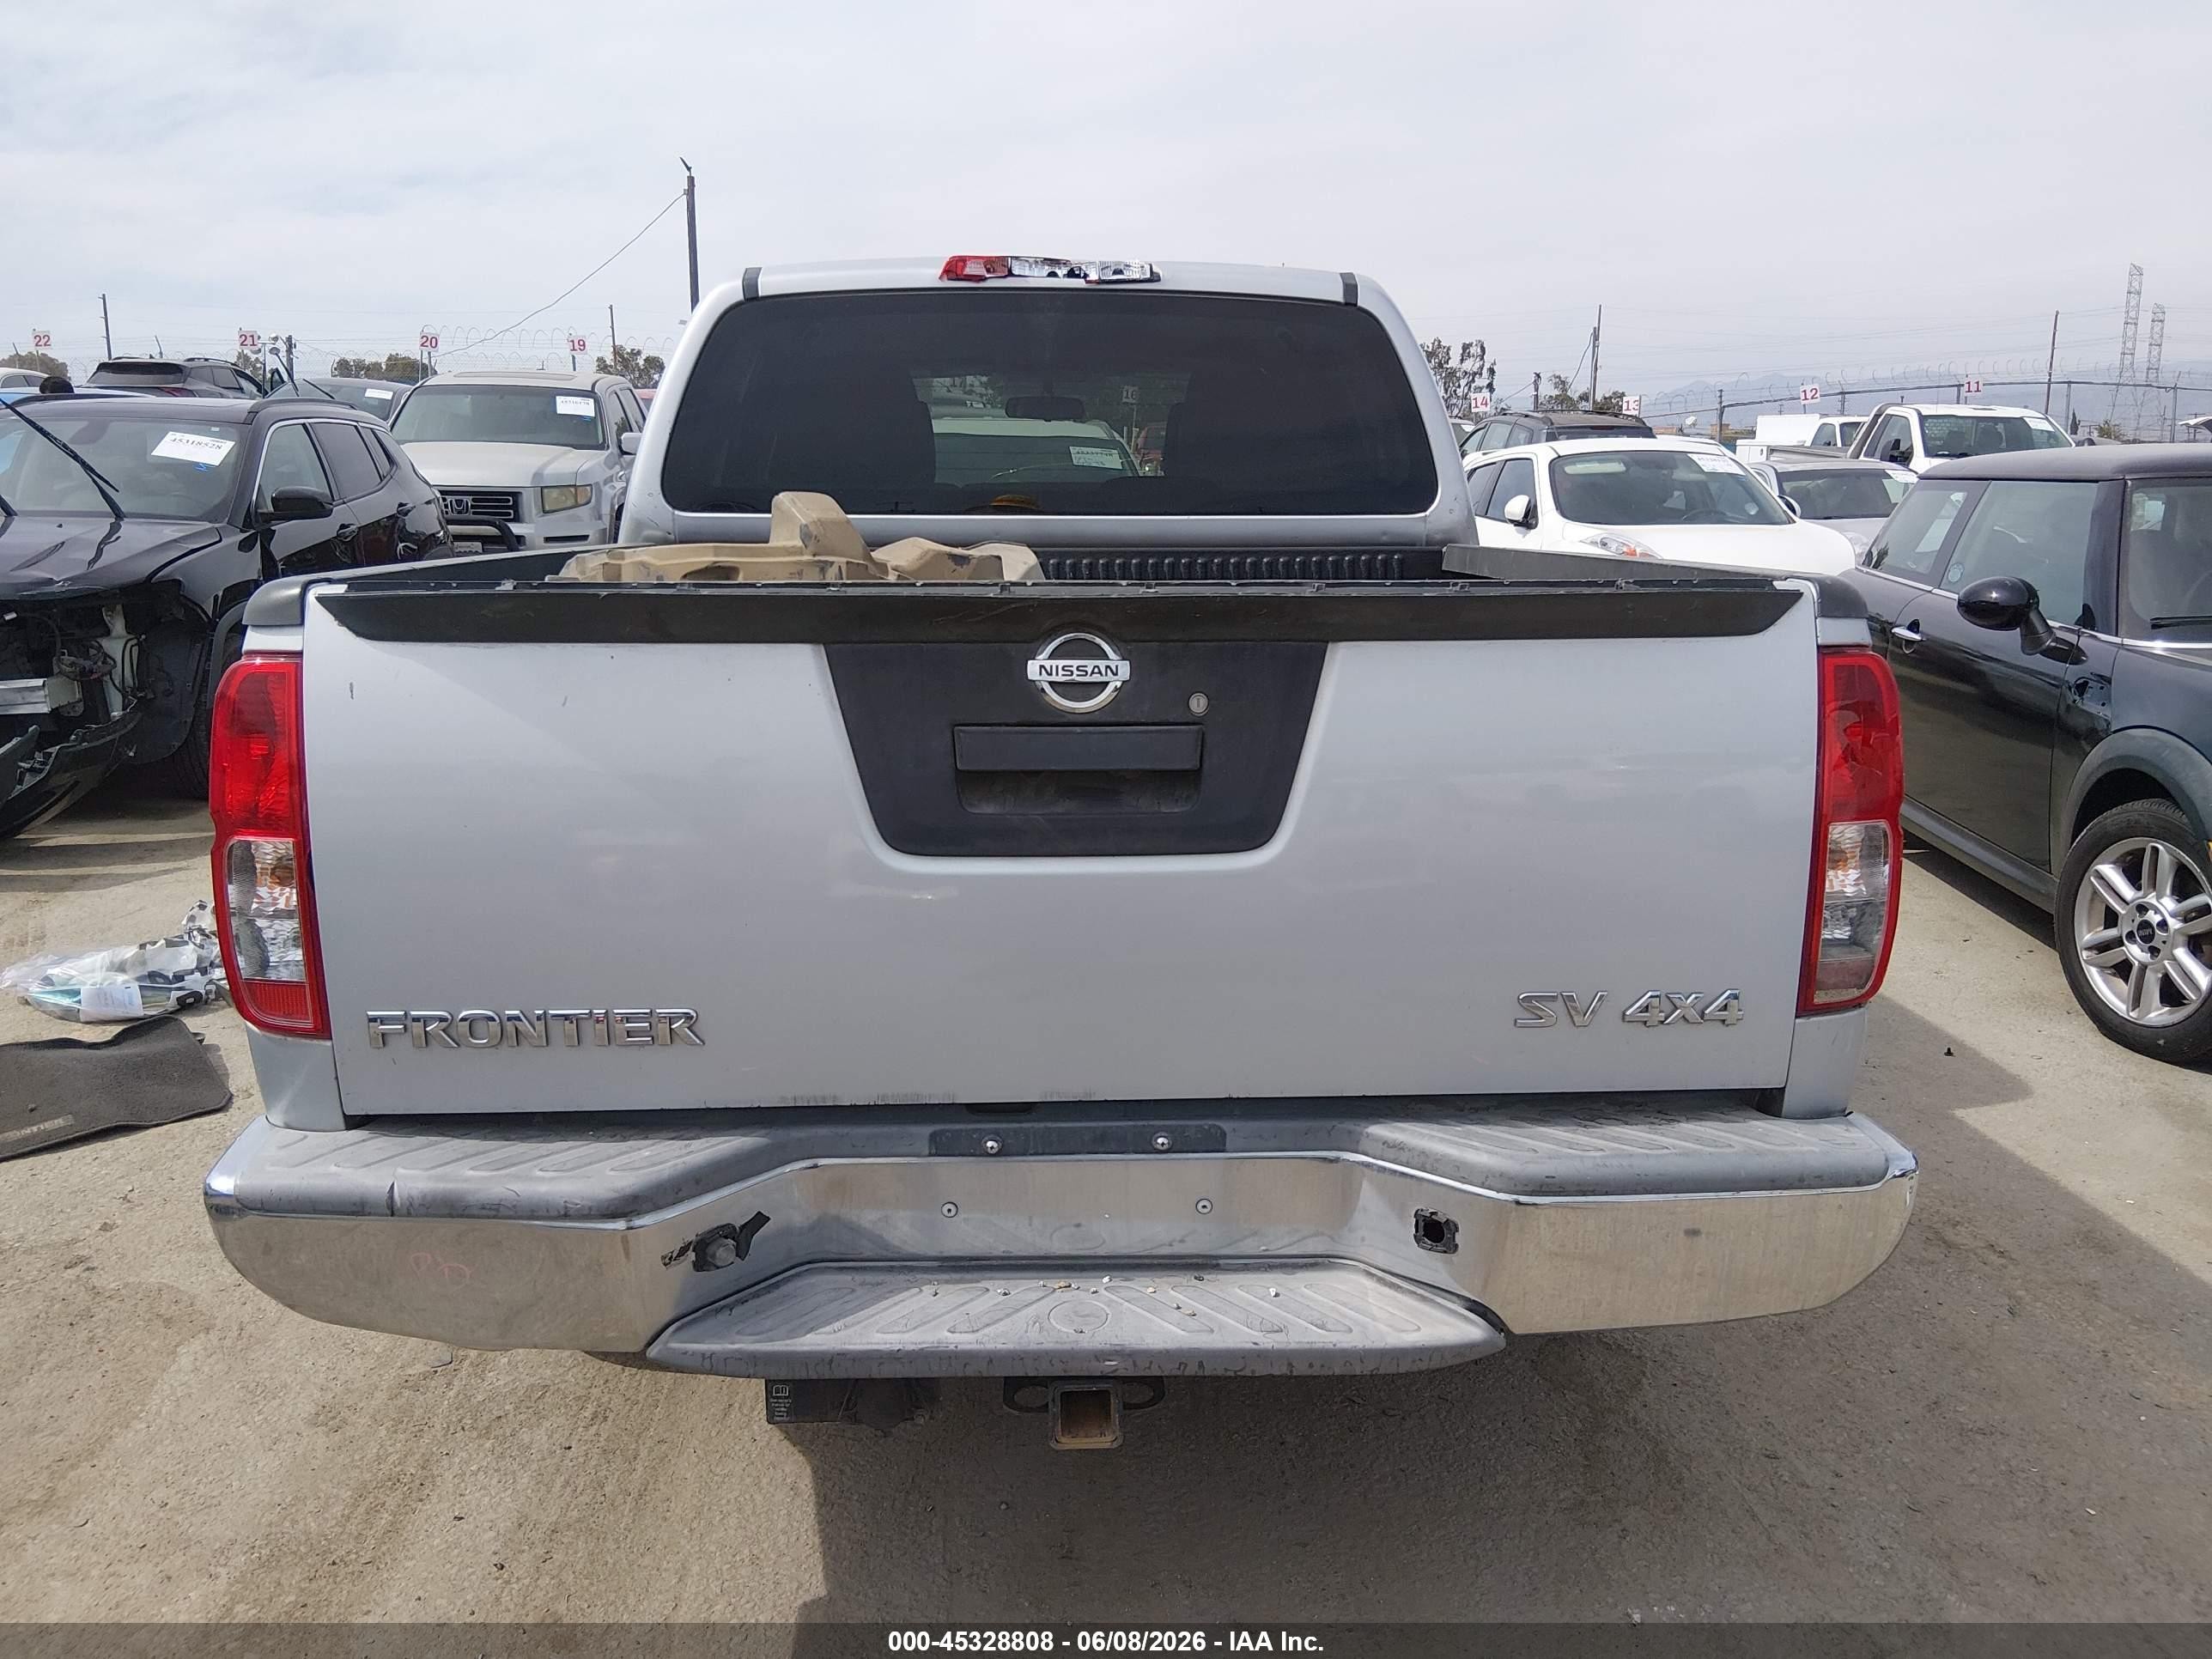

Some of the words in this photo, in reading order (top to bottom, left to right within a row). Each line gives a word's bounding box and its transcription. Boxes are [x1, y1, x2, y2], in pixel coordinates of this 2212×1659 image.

[33, 334, 52, 347] 22
[239, 333, 258, 346] 21
[420, 335, 438, 349] 20
[569, 338, 586, 351] 19
[1965, 380, 1982, 392] 11
[1801, 387, 1819, 401] 12
[1472, 396, 1489, 409] 14
[1624, 399, 1639, 411] 13
[1038, 664, 1120, 678] NISSAN
[1514, 991, 1608, 1028] SV
[365, 1008, 706, 1048] FRONTIER
